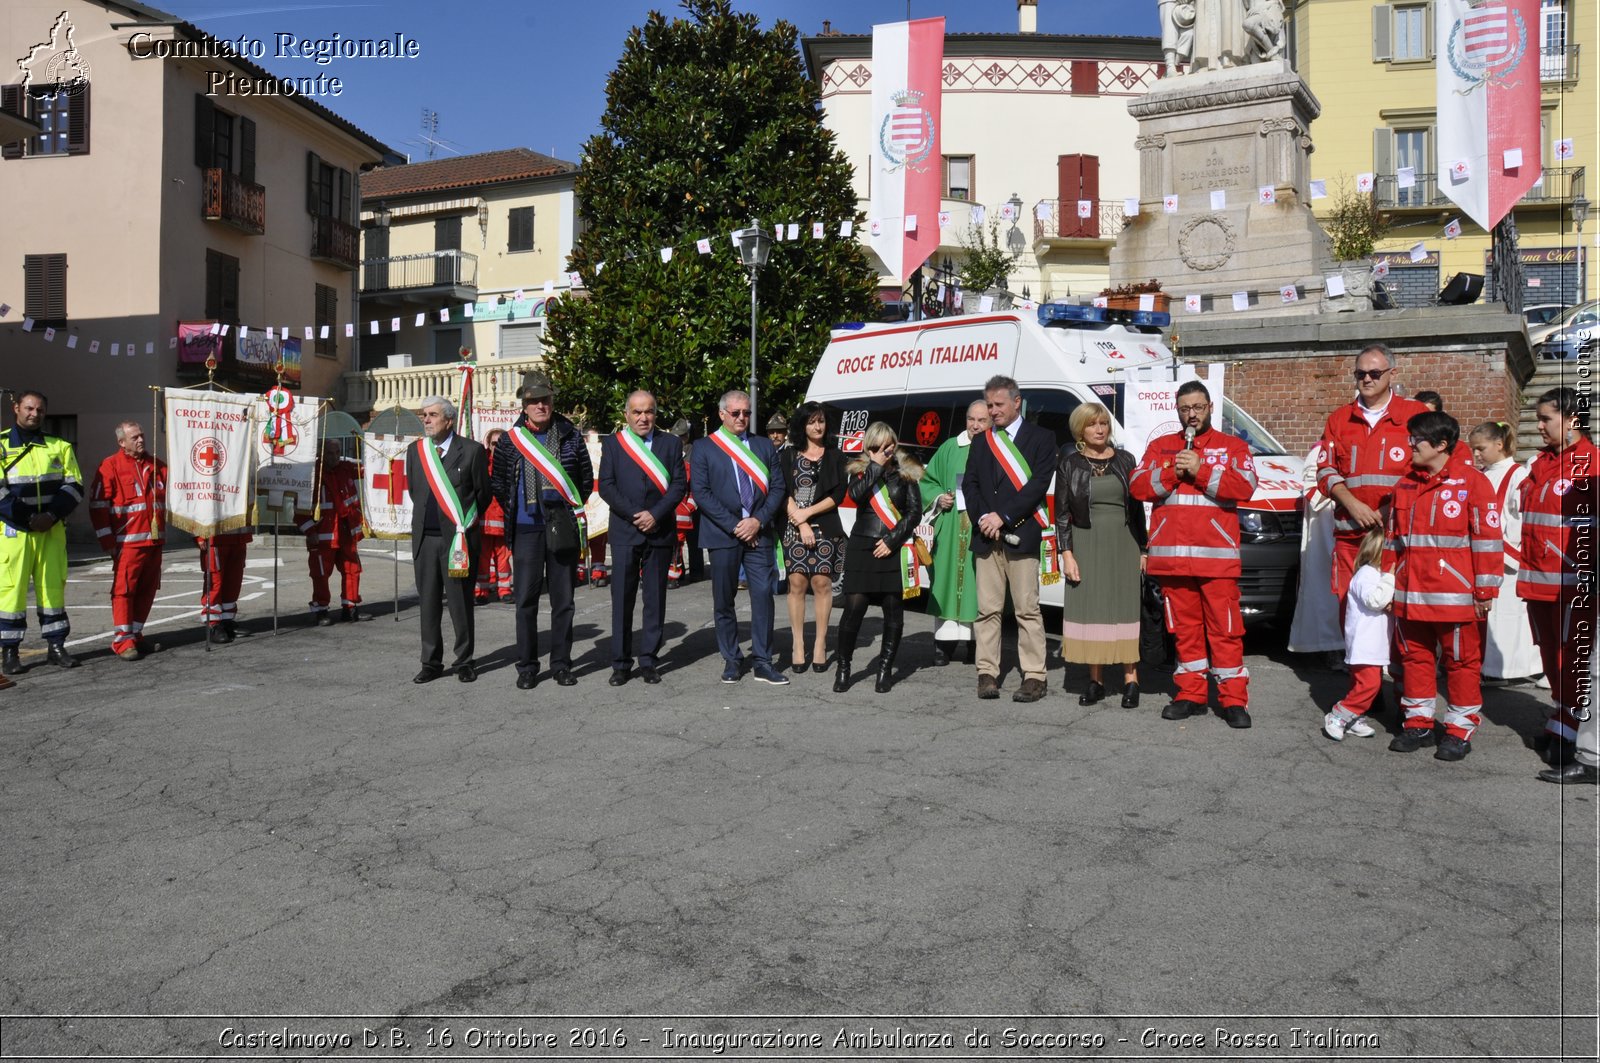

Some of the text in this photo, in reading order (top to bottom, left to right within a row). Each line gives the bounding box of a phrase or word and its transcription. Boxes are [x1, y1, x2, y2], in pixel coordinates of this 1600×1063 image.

[1206, 158, 1223, 167] DON
[1221, 165, 1250, 176] BOSCO
[1192, 179, 1239, 190] LA PATRIA
[1097, 341, 1117, 350] 118
[836, 342, 999, 375] CROCE ROSSA ITALIANA
[1138, 391, 1171, 401] CROCE
[175, 408, 248, 422] CROCE ROSSA
[845, 410, 869, 431] 118
[187, 420, 234, 432] ITALIANA
[174, 482, 240, 494] COMITATO LOCALE
[186, 493, 225, 503] DI CANELLI
